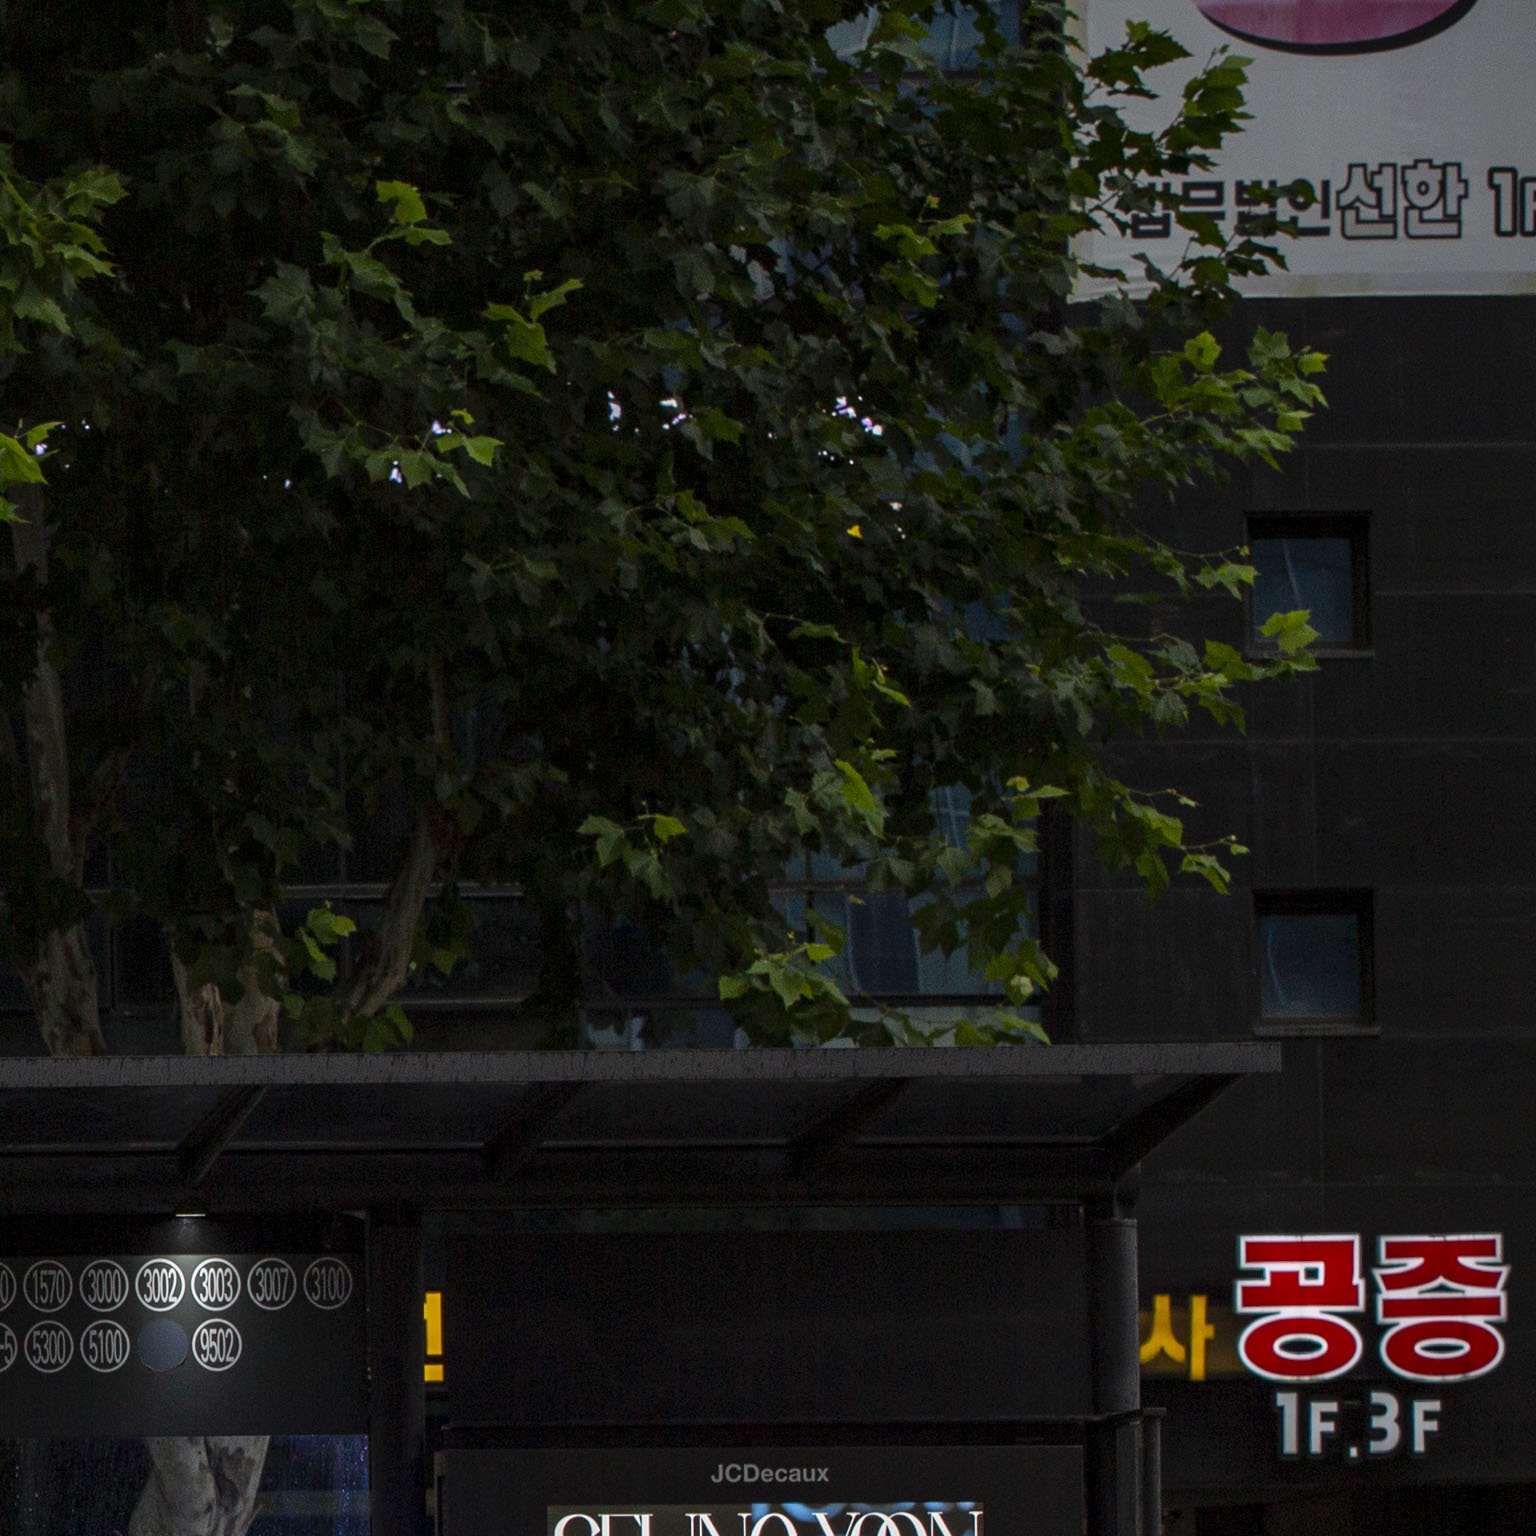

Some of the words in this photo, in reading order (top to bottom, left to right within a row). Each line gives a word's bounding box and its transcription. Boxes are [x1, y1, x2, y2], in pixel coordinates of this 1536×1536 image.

[32, 1272, 65, 1301] 1570
[88, 1271, 122, 1301] 3000
[142, 1270, 178, 1302] 3002
[198, 1270, 234, 1301] 3003
[254, 1270, 289, 1301] 3007
[310, 1269, 345, 1299] 3100
[1234, 1232, 1510, 1382] 공증
[32, 1332, 66, 1364] 5300
[88, 1331, 123, 1362] 5100
[199, 1329, 235, 1361] 9502
[710, 1464, 829, 1484] JCDecaux
